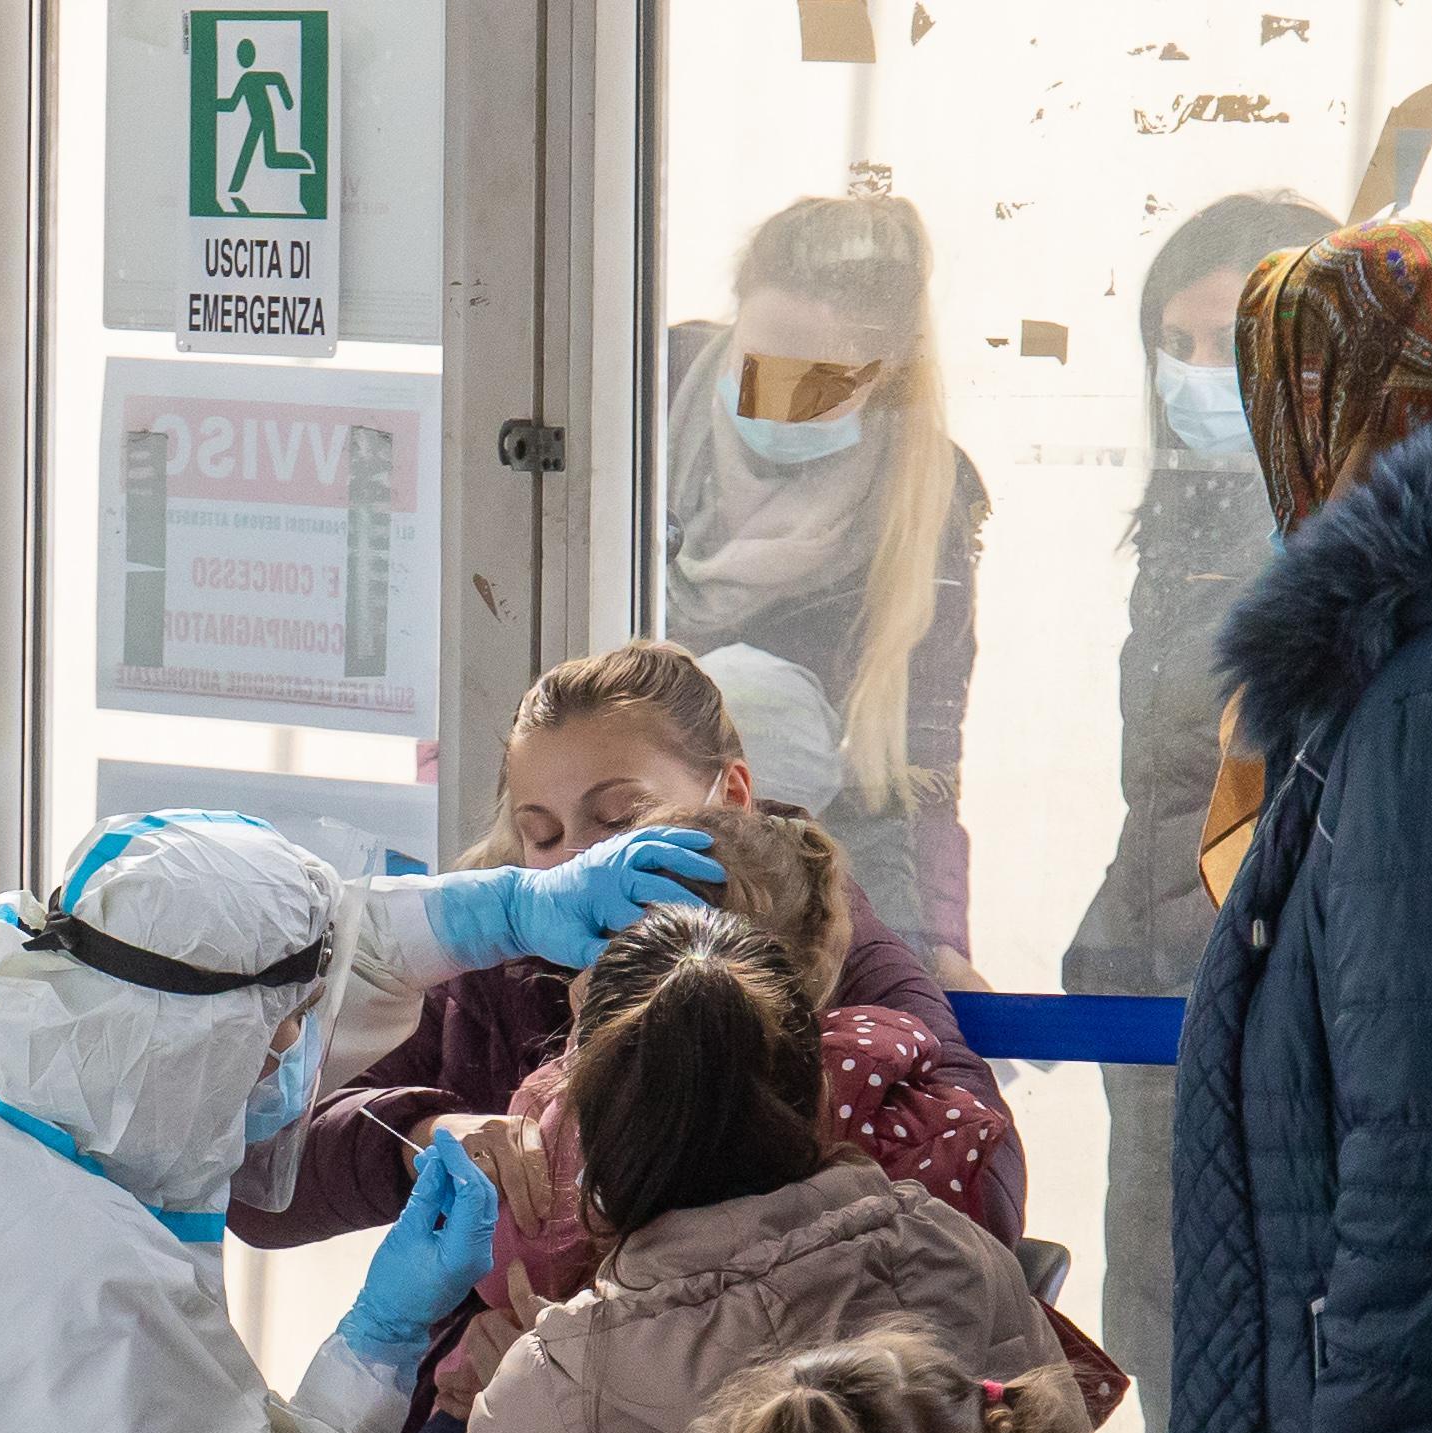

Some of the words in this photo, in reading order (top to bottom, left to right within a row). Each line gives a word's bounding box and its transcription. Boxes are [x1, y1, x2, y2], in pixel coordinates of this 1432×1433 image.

[205, 238, 283, 278] USCITA
[289, 240, 311, 280] DI
[188, 292, 326, 337] EMERGENZA
